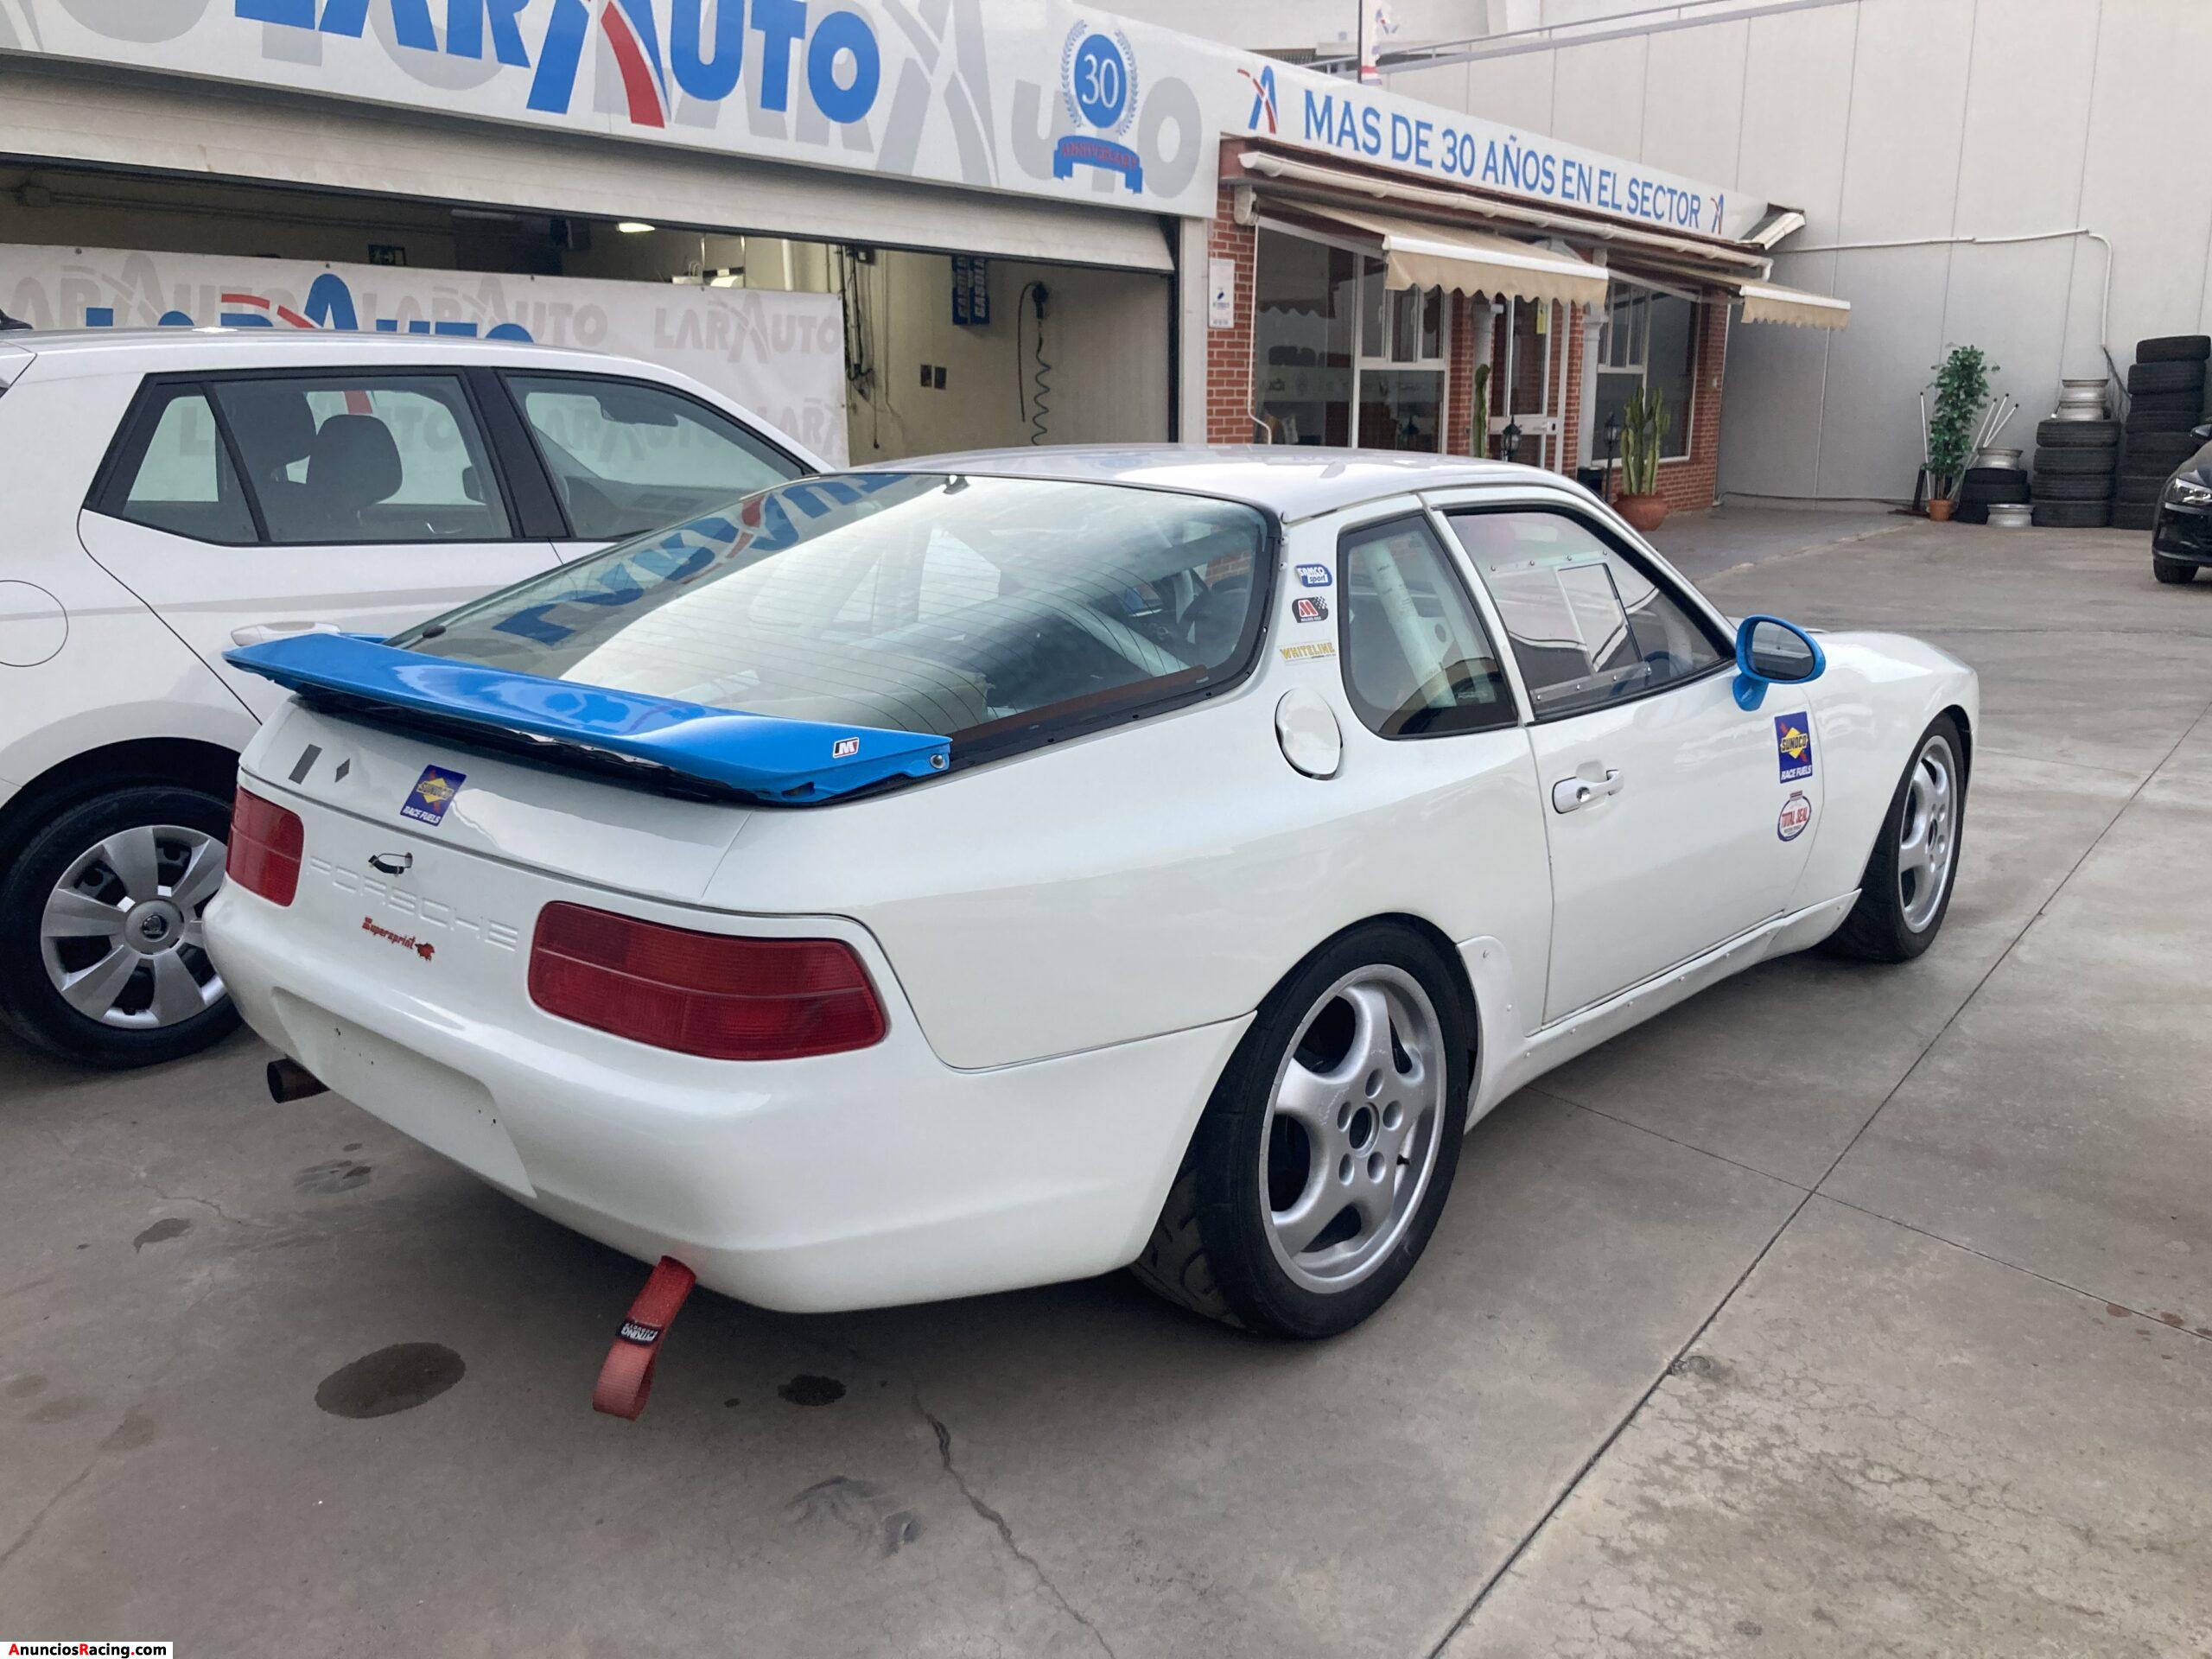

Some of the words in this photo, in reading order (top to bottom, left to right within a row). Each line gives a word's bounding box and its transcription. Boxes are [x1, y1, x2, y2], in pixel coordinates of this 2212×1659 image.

[1081, 53, 1120, 109] 30
[1304, 88, 1382, 156] MAS
[1391, 112, 1433, 169] DE
[1440, 128, 1476, 178] 30
[1481, 134, 1555, 195] AÑOS
[1560, 158, 1593, 204] EN
[1597, 168, 1623, 211] EL
[1626, 176, 1702, 229] SECTOR
[1280, 642, 1335, 659] WHITELINE
[1781, 734, 1808, 752] SUNOCO
[1781, 768, 1796, 780] RACE
[1796, 765, 1812, 778] FUELS
[402, 805, 423, 818] RACE
[418, 810, 442, 824] FUELS
